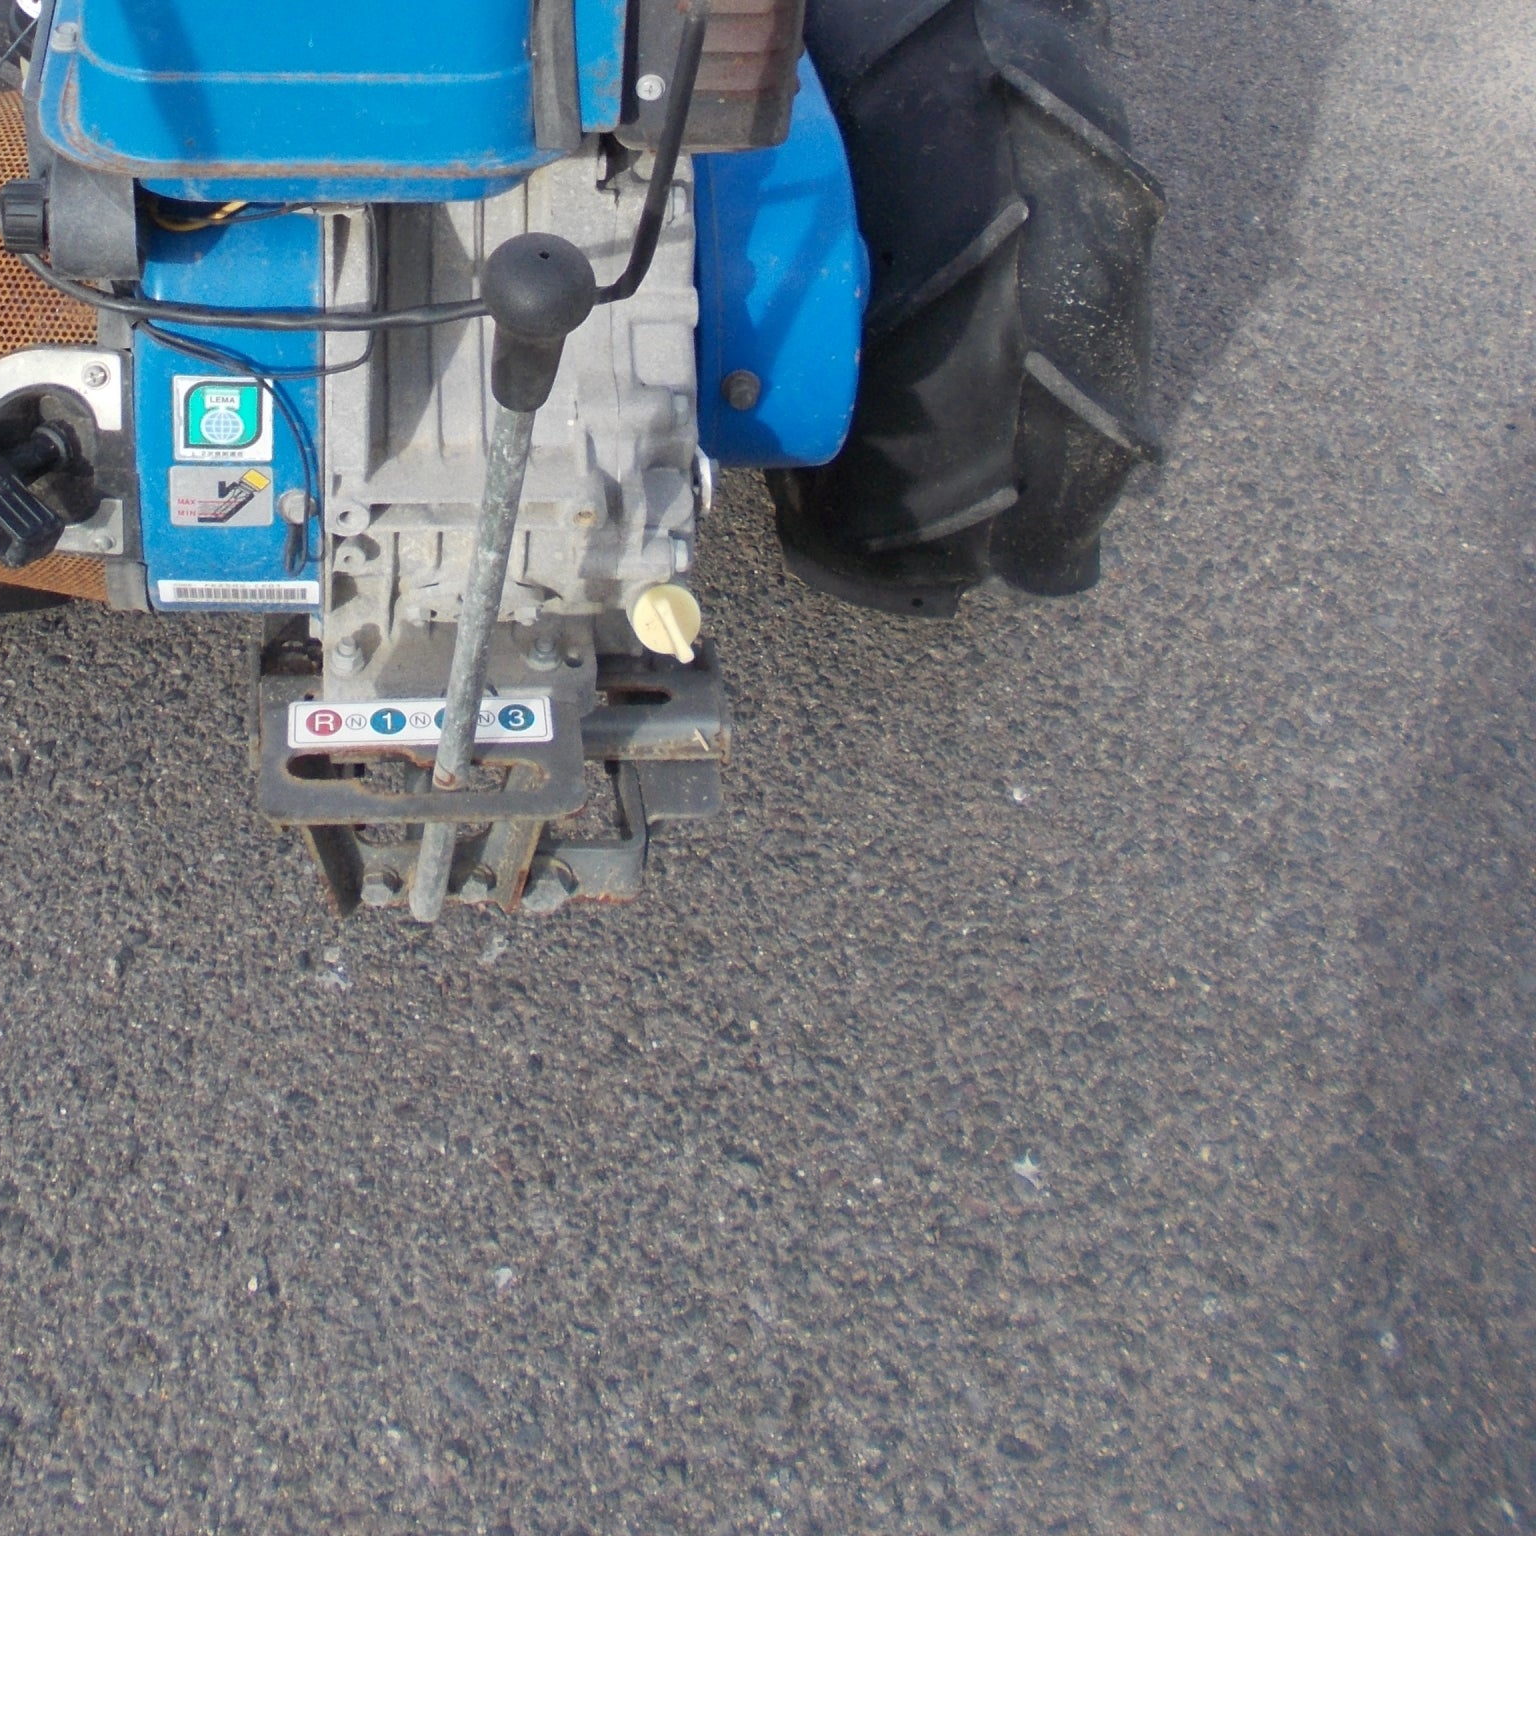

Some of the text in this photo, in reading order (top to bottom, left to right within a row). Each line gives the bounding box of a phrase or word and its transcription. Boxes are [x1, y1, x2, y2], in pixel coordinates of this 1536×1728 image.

[209, 396, 236, 404] LEMA
[315, 713, 335, 732] R
[508, 709, 524, 727] 3
